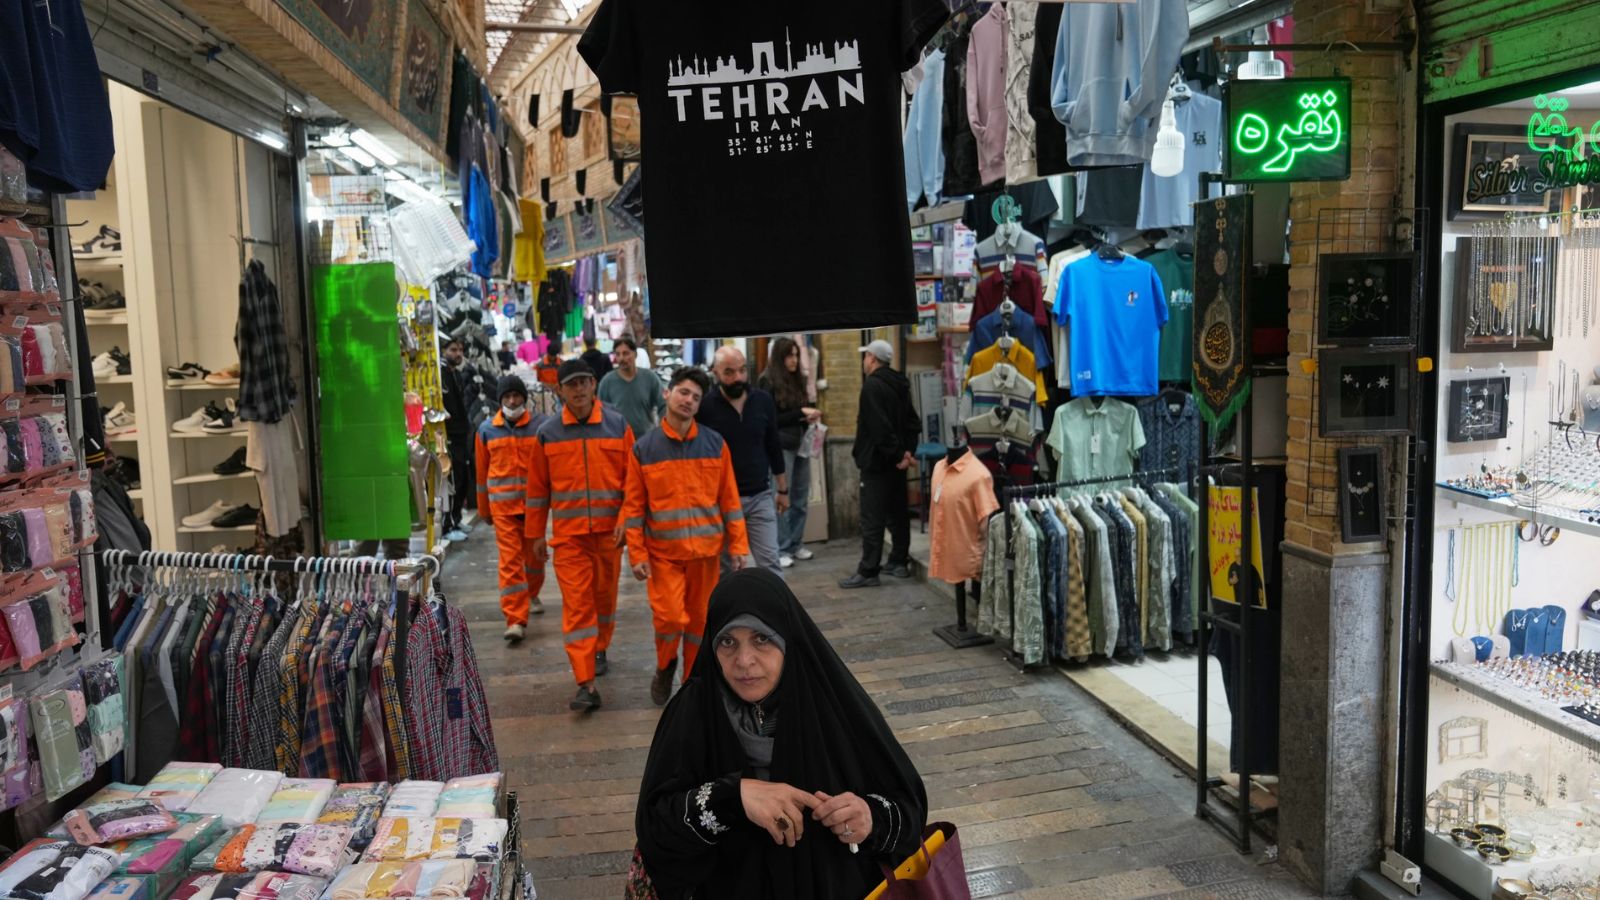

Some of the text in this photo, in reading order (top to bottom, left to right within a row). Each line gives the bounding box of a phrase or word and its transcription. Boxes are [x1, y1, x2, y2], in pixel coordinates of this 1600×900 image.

[667, 72, 865, 122] TEHRAN
[735, 116, 801, 134] IRAN
[1236, 89, 1341, 172] نقره
[805, 130, 812, 139] N
[806, 140, 813, 149] E
